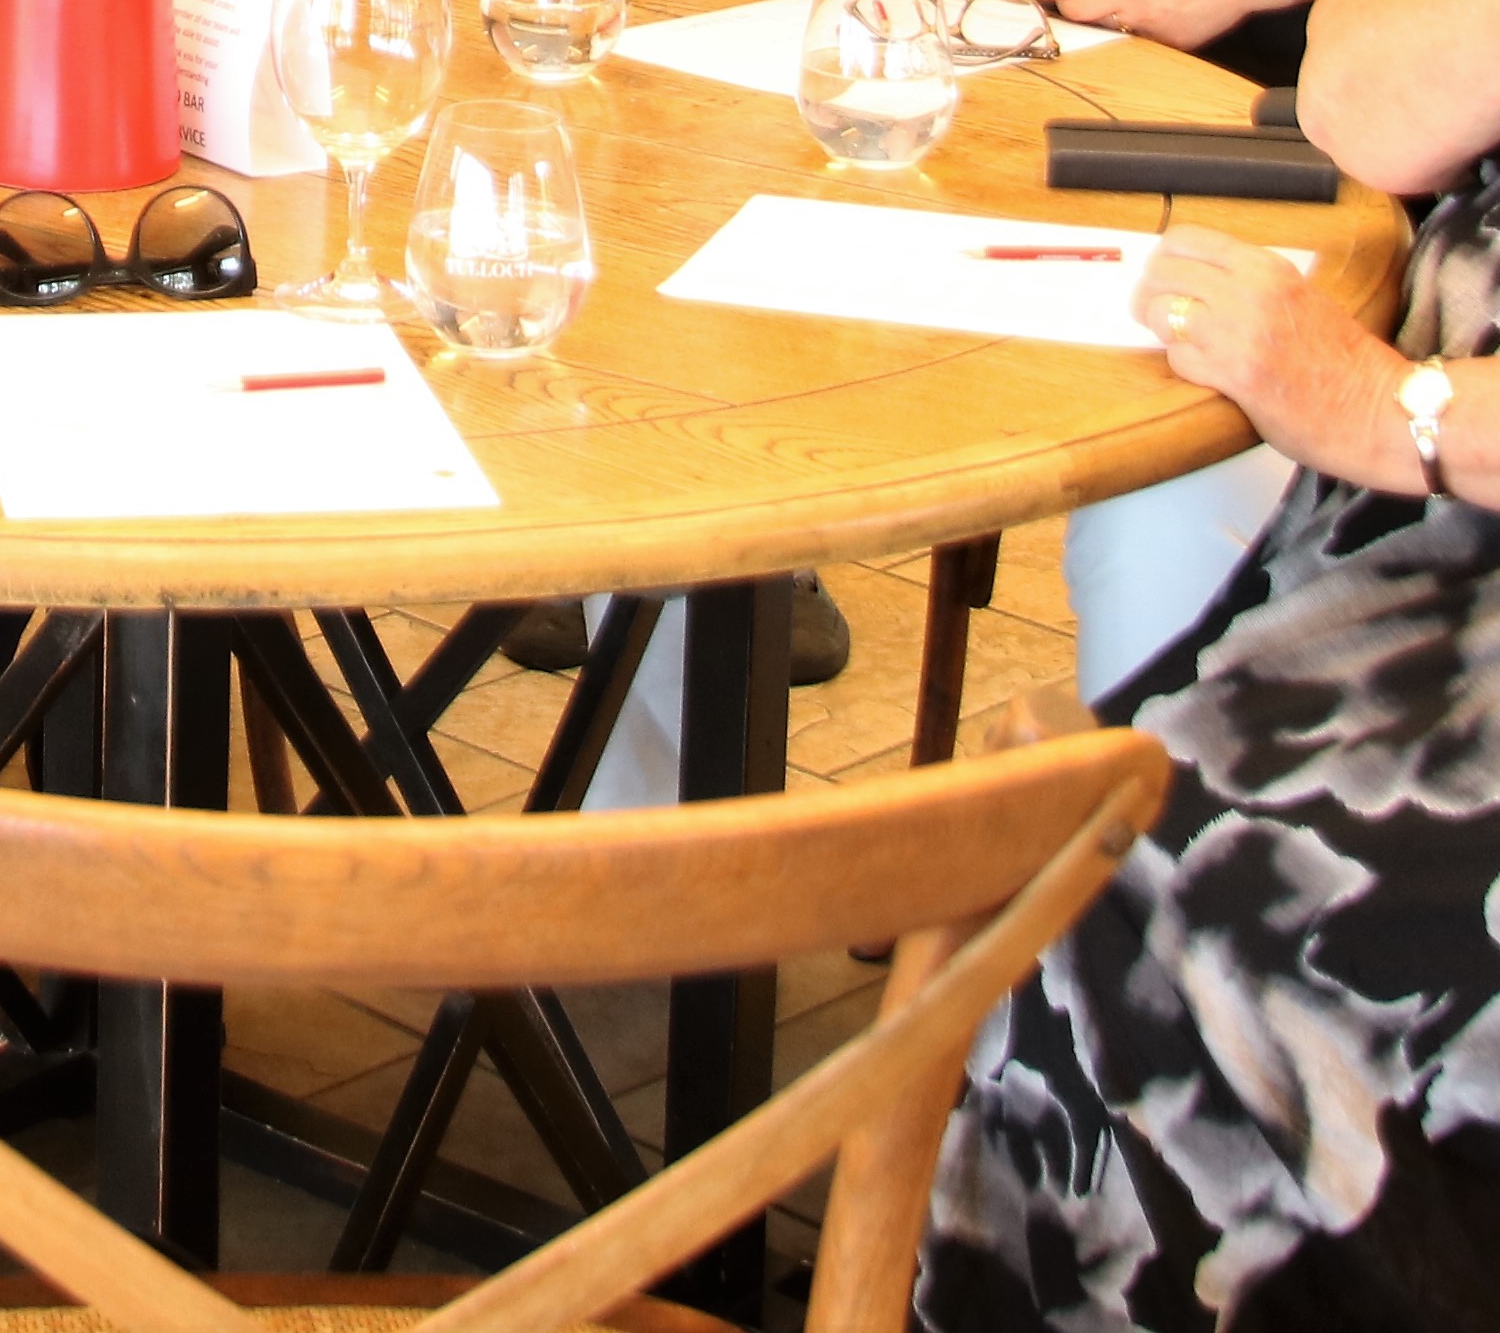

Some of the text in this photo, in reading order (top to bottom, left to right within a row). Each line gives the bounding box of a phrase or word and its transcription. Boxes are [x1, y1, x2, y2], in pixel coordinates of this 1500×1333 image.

[183, 90, 205, 112] BAR
[179, 124, 207, 147] RVICE
[445, 257, 535, 278] TULLOCH
